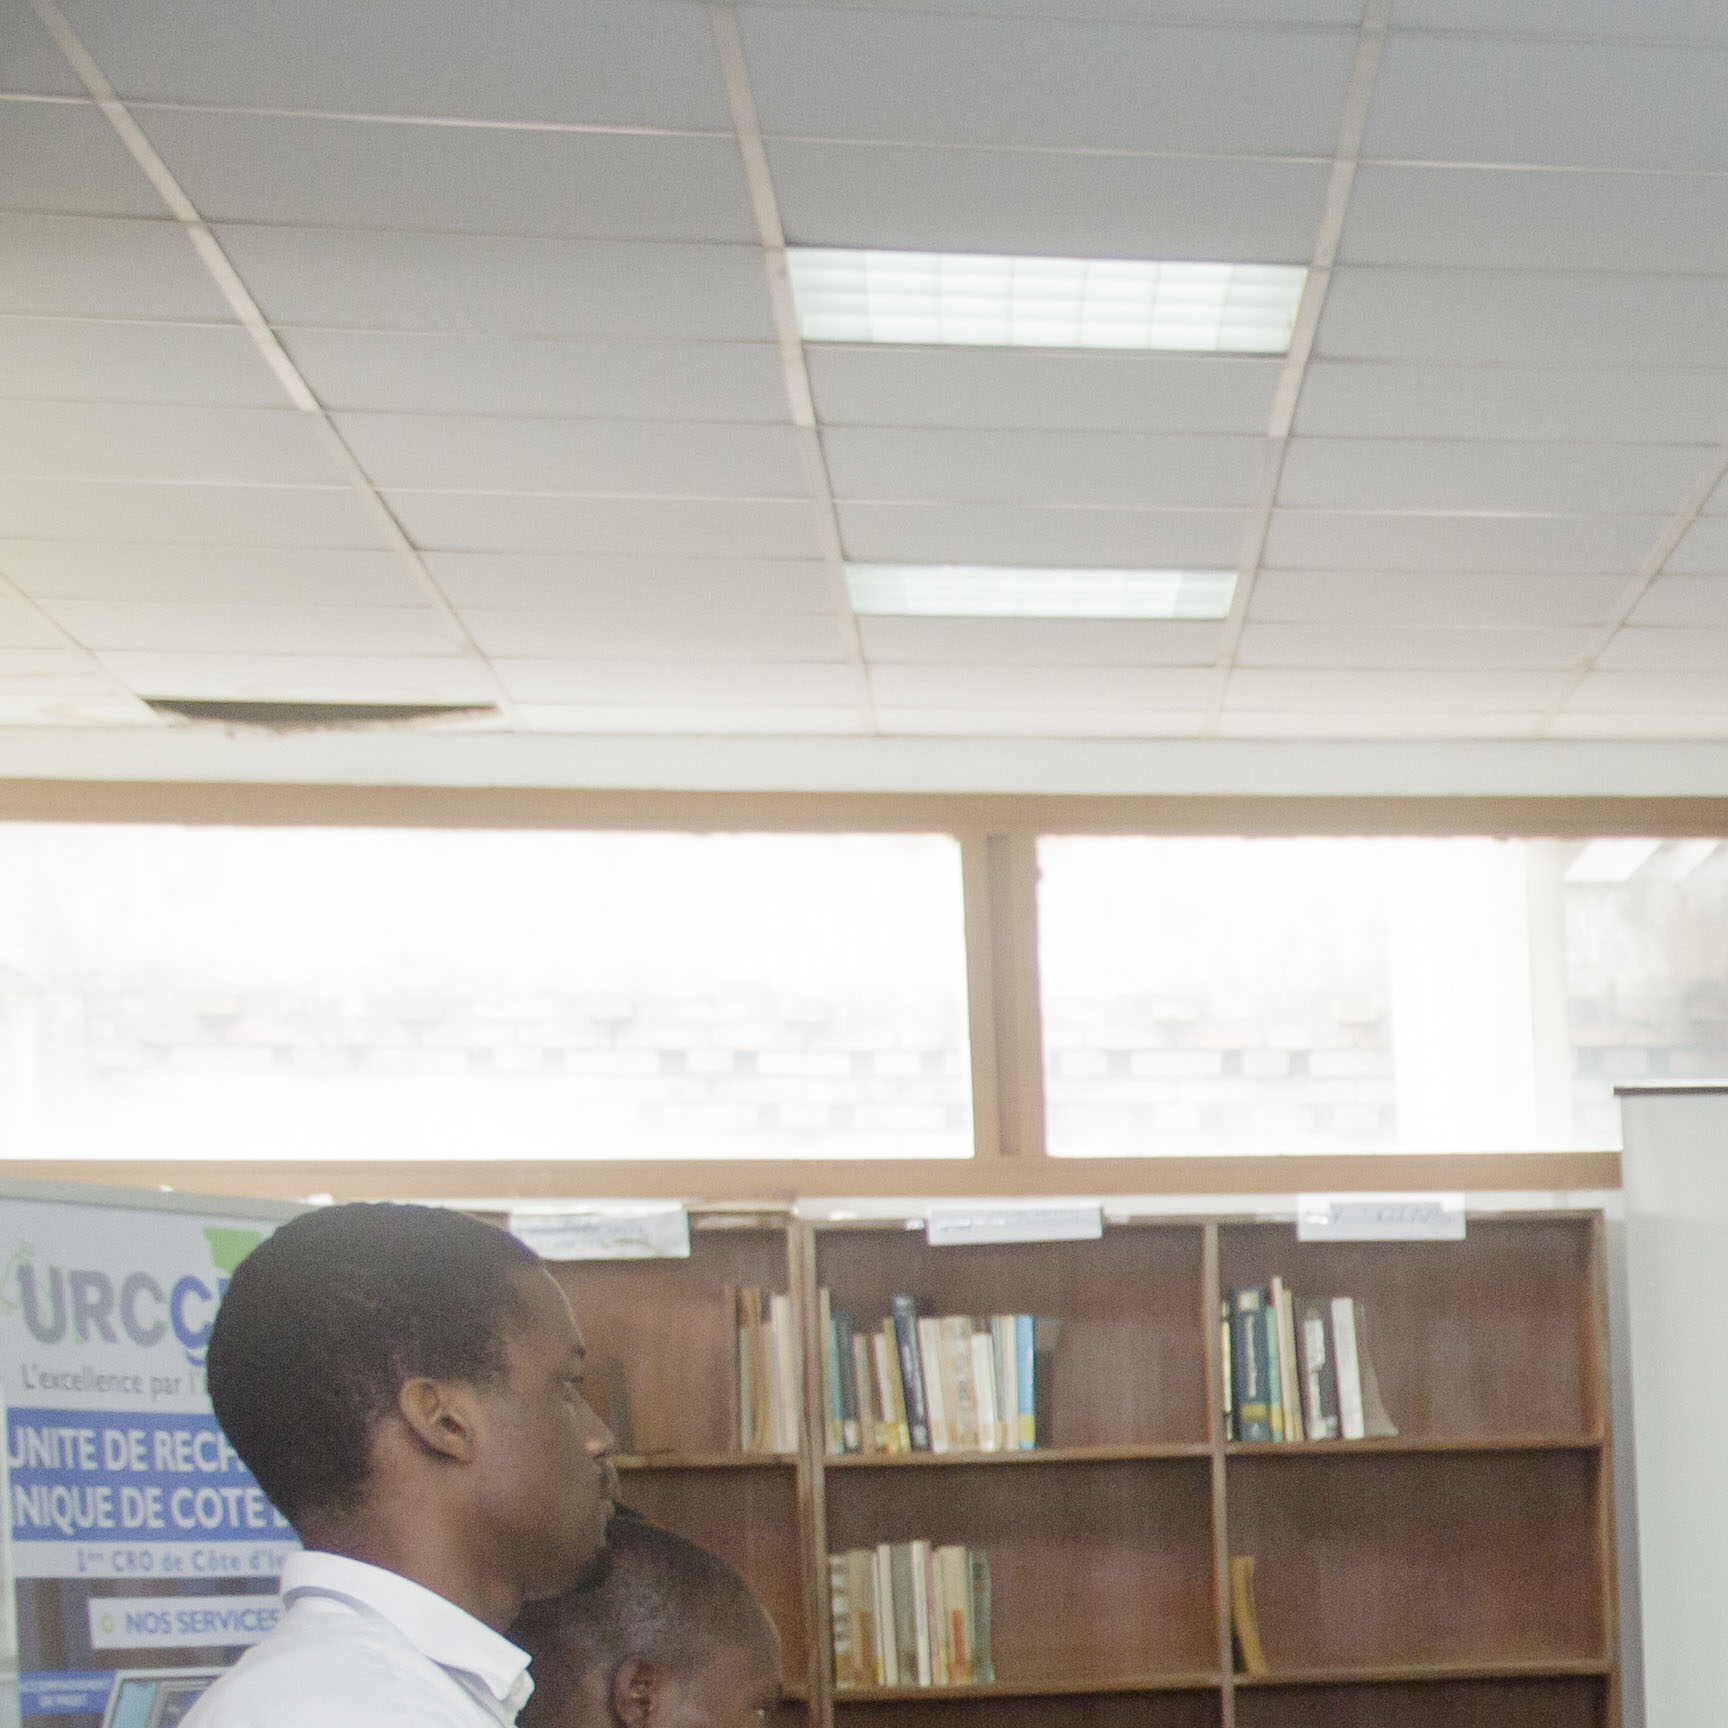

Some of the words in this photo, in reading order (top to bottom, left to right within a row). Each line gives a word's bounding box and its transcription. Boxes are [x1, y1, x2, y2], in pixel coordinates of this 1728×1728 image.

[16, 1264, 231, 1348] URCC
[22, 1362, 144, 1394] L'excellence
[151, 1376, 183, 1399] par
[103, 1428, 148, 1472] DE
[153, 1430, 248, 1473] RECH
[12, 1484, 117, 1537] NIQUE
[120, 1486, 165, 1529] DE
[171, 1486, 268, 1530] COTE
[111, 1549, 154, 1572] CRO
[162, 1550, 184, 1572] de
[125, 1610, 173, 1635] NOS
